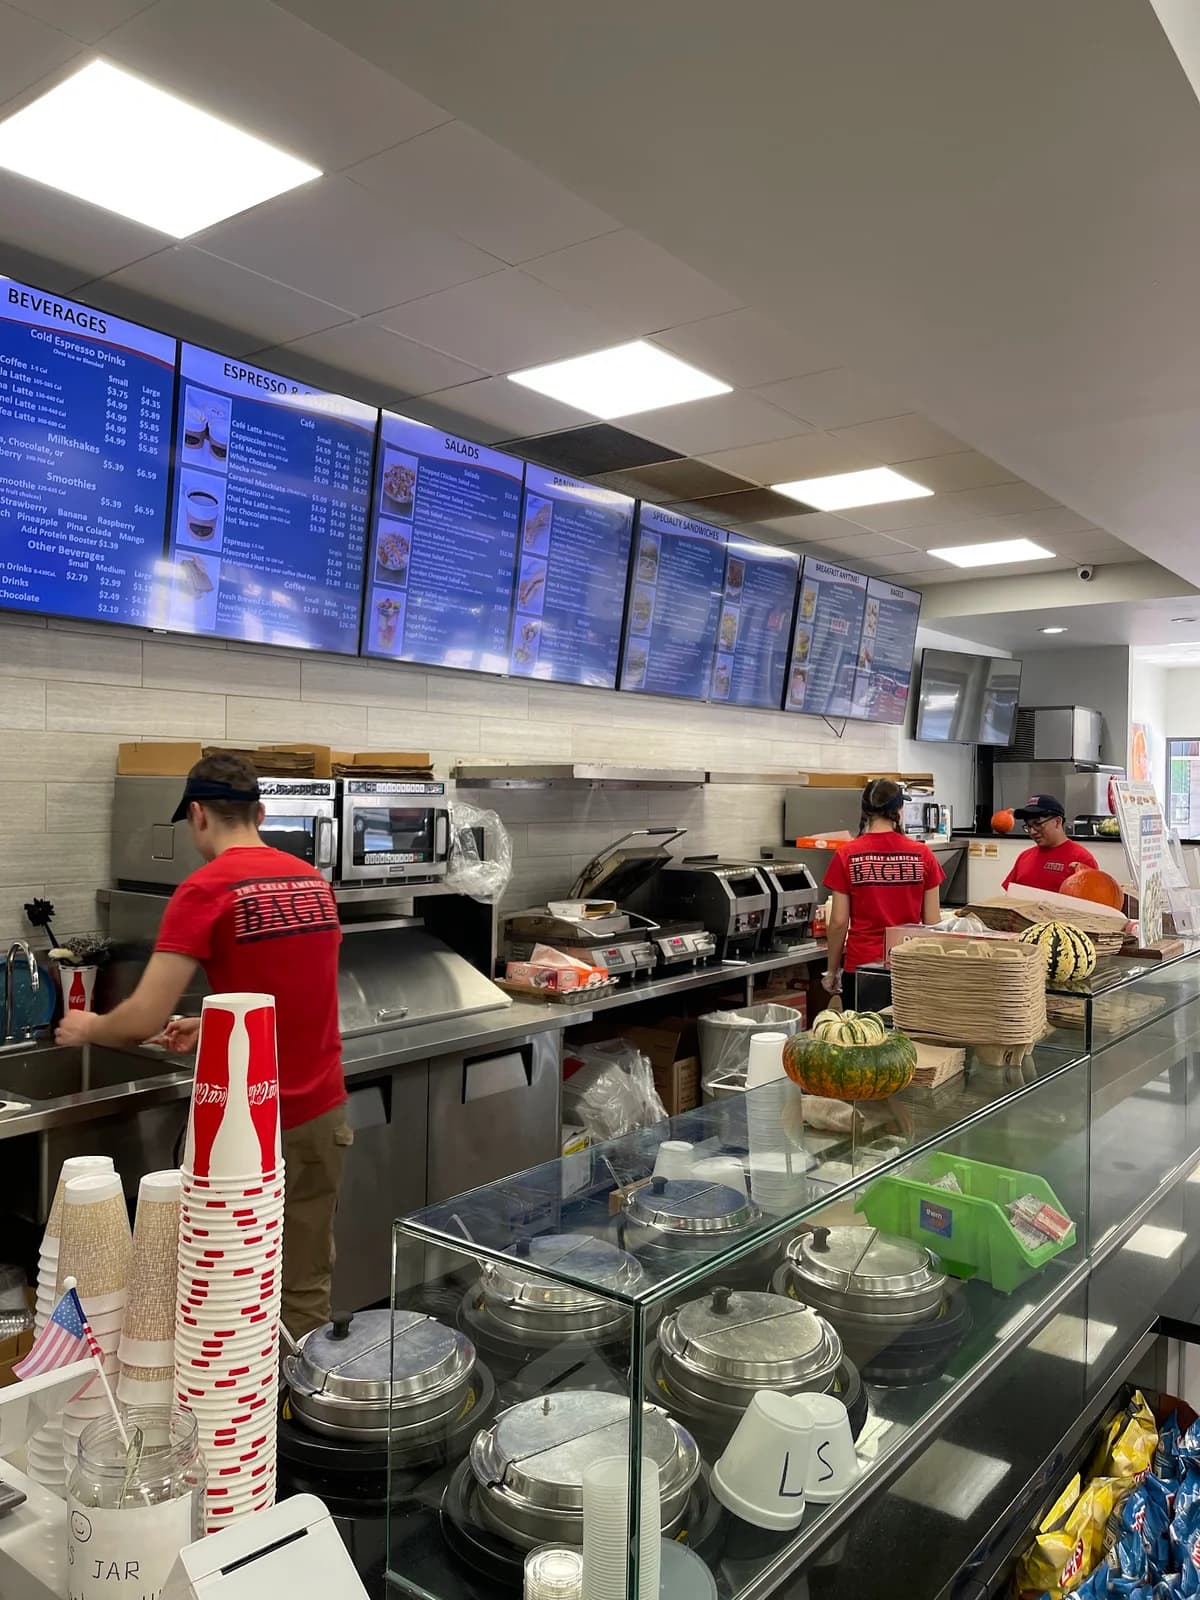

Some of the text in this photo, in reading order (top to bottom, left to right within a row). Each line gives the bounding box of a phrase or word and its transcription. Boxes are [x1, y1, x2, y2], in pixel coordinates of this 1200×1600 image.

[8, 288, 106, 334] BEVERAGES
[31, 329, 125, 366] Cold Espresso Drinks
[0, 355, 27, 369] Coffee
[10, 370, 31, 383] Latte
[224, 363, 287, 394] ESPRESSO
[12, 384, 34, 397] Latte
[109, 375, 160, 397] Small Large
[15, 398, 36, 410] Latte
[107, 386, 161, 409] $3.75 $4.35
[107, 398, 128, 411] $4.99
[14, 410, 35, 423] Latte
[106, 410, 127, 423] $4.99
[105, 422, 126, 434] $4.99
[247, 424, 263, 435] Latte
[48, 433, 100, 454] Milkshakes
[104, 433, 126, 446] $4.99
[229, 431, 266, 447] Cappuccino
[246, 446, 266, 457] Mocha
[445, 438, 479, 459] SALADS
[8, 437, 53, 456] Chocolate,
[103, 460, 124, 472] $5.39
[137, 468, 156, 480] $6.59
[47, 472, 96, 490] Smoothies
[0, 477, 35, 490] moothie
[100, 497, 122, 508] $5.39
[134, 504, 154, 516] $6.59
[227, 483, 261, 497] Americano
[227, 494, 241, 503] Chai
[242, 497, 252, 506] Tea
[253, 500, 269, 510] Latte
[0, 496, 135, 532] Strawberry Banana Raspberry
[225, 515, 236, 524] Hot
[236, 518, 249, 526] Tea
[226, 504, 238, 513] Hot
[239, 508, 269, 520] Chocolate
[17, 512, 58, 527] Pineapple
[85, 526, 111, 537] Colada
[119, 532, 145, 544] Mango
[652, 511, 720, 541] SPECIALTY SANDWICHES
[21, 525, 118, 550] Add Protein Booster $1.39
[224, 536, 250, 548] Espresso
[28, 540, 105, 562] Other Beverages
[222, 547, 249, 559] Flavored
[250, 553, 264, 562] Shot
[7, 562, 32, 573] Drinks
[66, 571, 88, 582] $2.79
[100, 577, 121, 587] $2.99
[68, 559, 89, 569] Small
[96, 563, 126, 575] Medium
[816, 563, 840, 577] BREAKFAST
[2, 576, 120, 600] Drinks $2.49
[284, 581, 306, 591] Coffee
[0, 590, 119, 613] Chocolate $2.19
[853, 863, 922, 881] BAGEL
[233, 885, 256, 896] THE
[259, 882, 288, 891] GREAT
[817, 1441, 834, 1482] S
[779, 1451, 803, 1497] L
[91, 1559, 140, 1581] JAR
